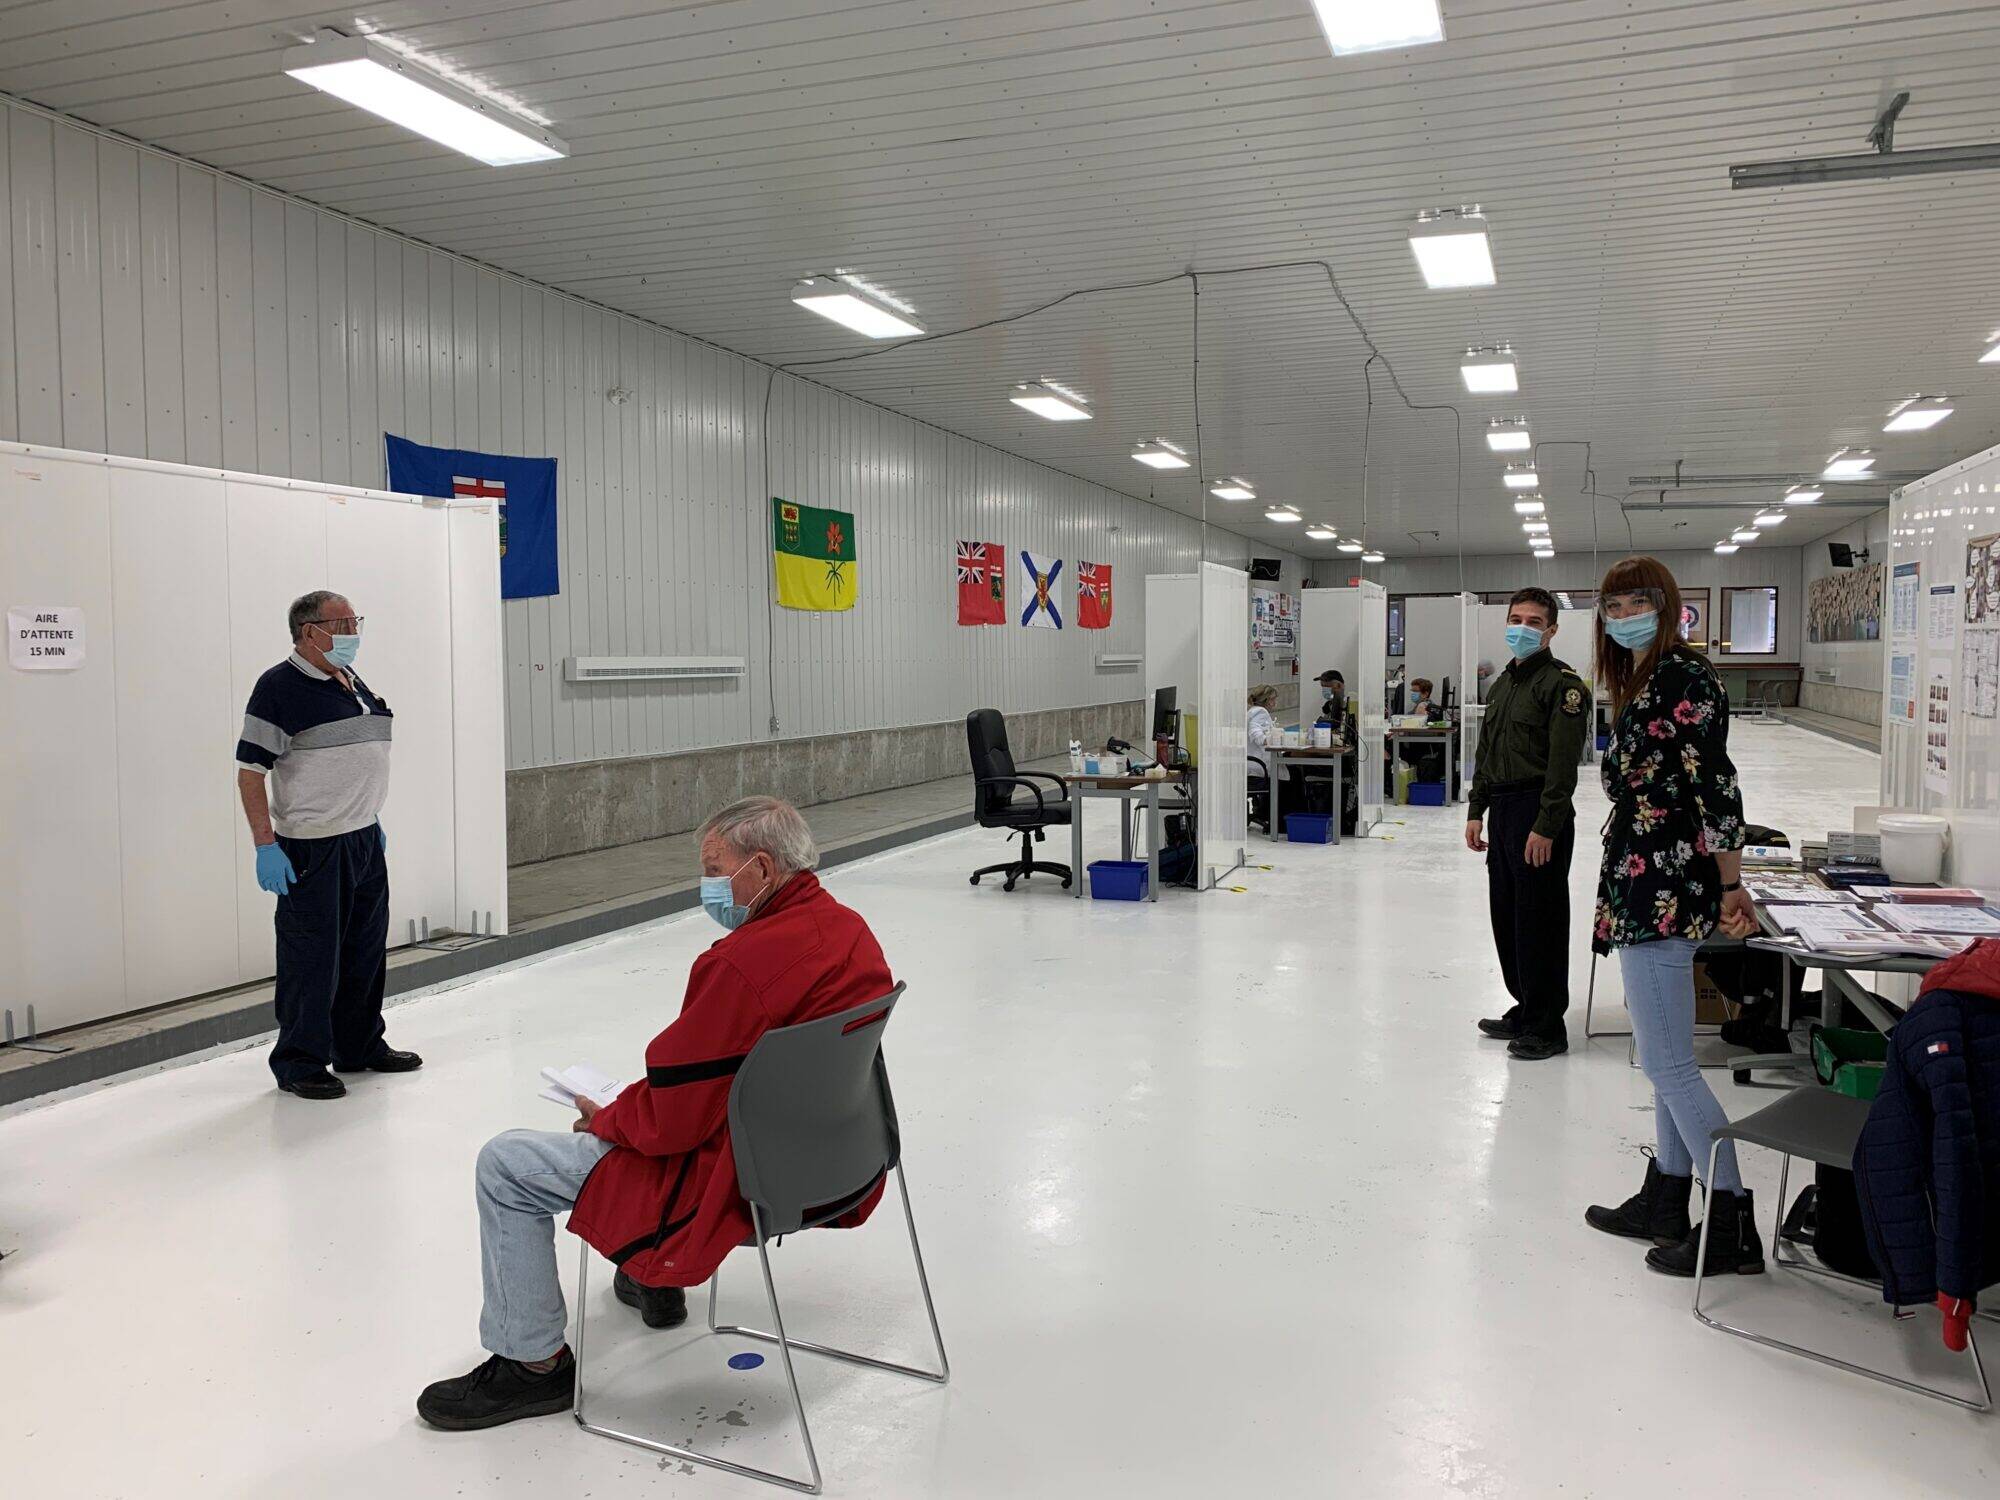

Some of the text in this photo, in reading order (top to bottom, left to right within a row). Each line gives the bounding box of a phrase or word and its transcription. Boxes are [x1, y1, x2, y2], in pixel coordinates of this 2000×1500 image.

[35, 614, 59, 623] AIRE
[20, 629, 74, 639] D'ATTENTE
[30, 646, 65, 656] 15 MIN
